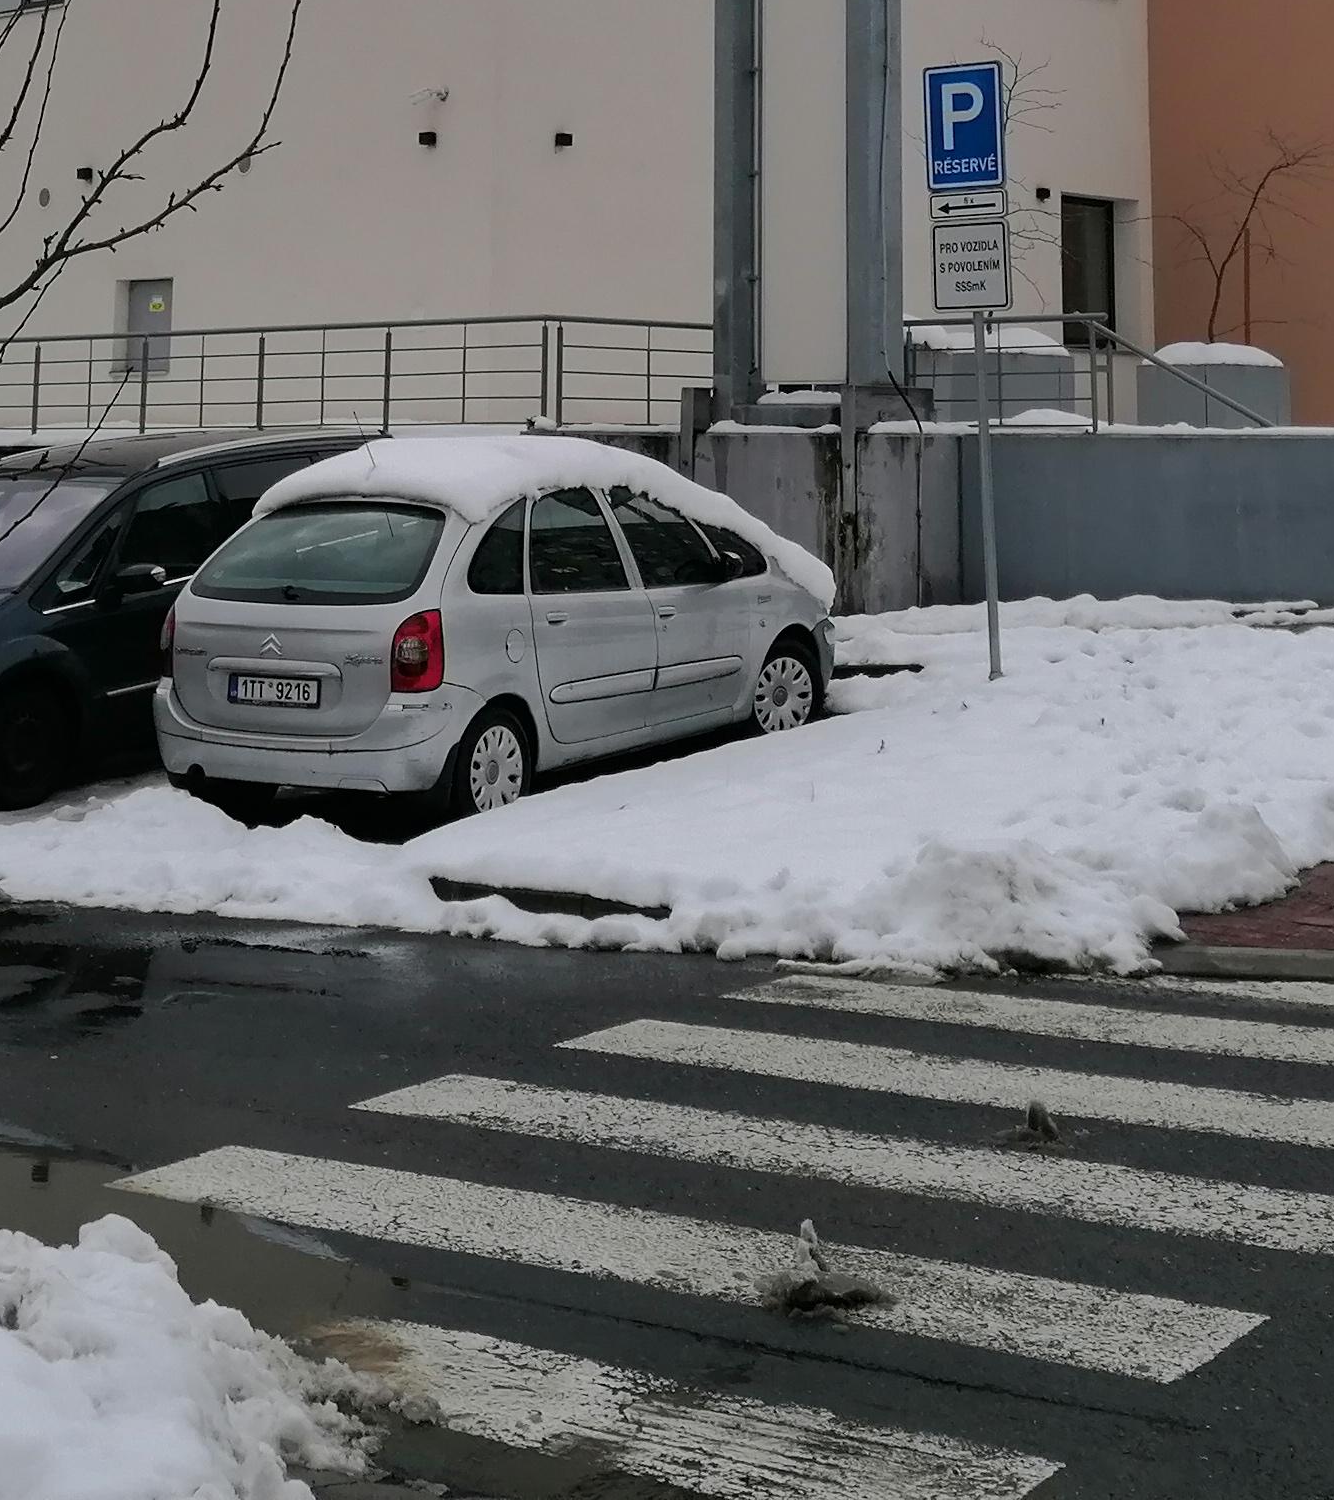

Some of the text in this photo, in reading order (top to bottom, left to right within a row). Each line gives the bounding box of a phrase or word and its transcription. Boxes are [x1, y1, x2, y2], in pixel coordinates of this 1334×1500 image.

[941, 82, 984, 151] P
[934, 153, 996, 175] RÉSERVÉ
[939, 239, 999, 254] PRO VOZIDLA
[939, 257, 1000, 273] S POVOLENÍM
[955, 280, 987, 292] SSSmK
[242, 679, 311, 702] 1TT 9216
